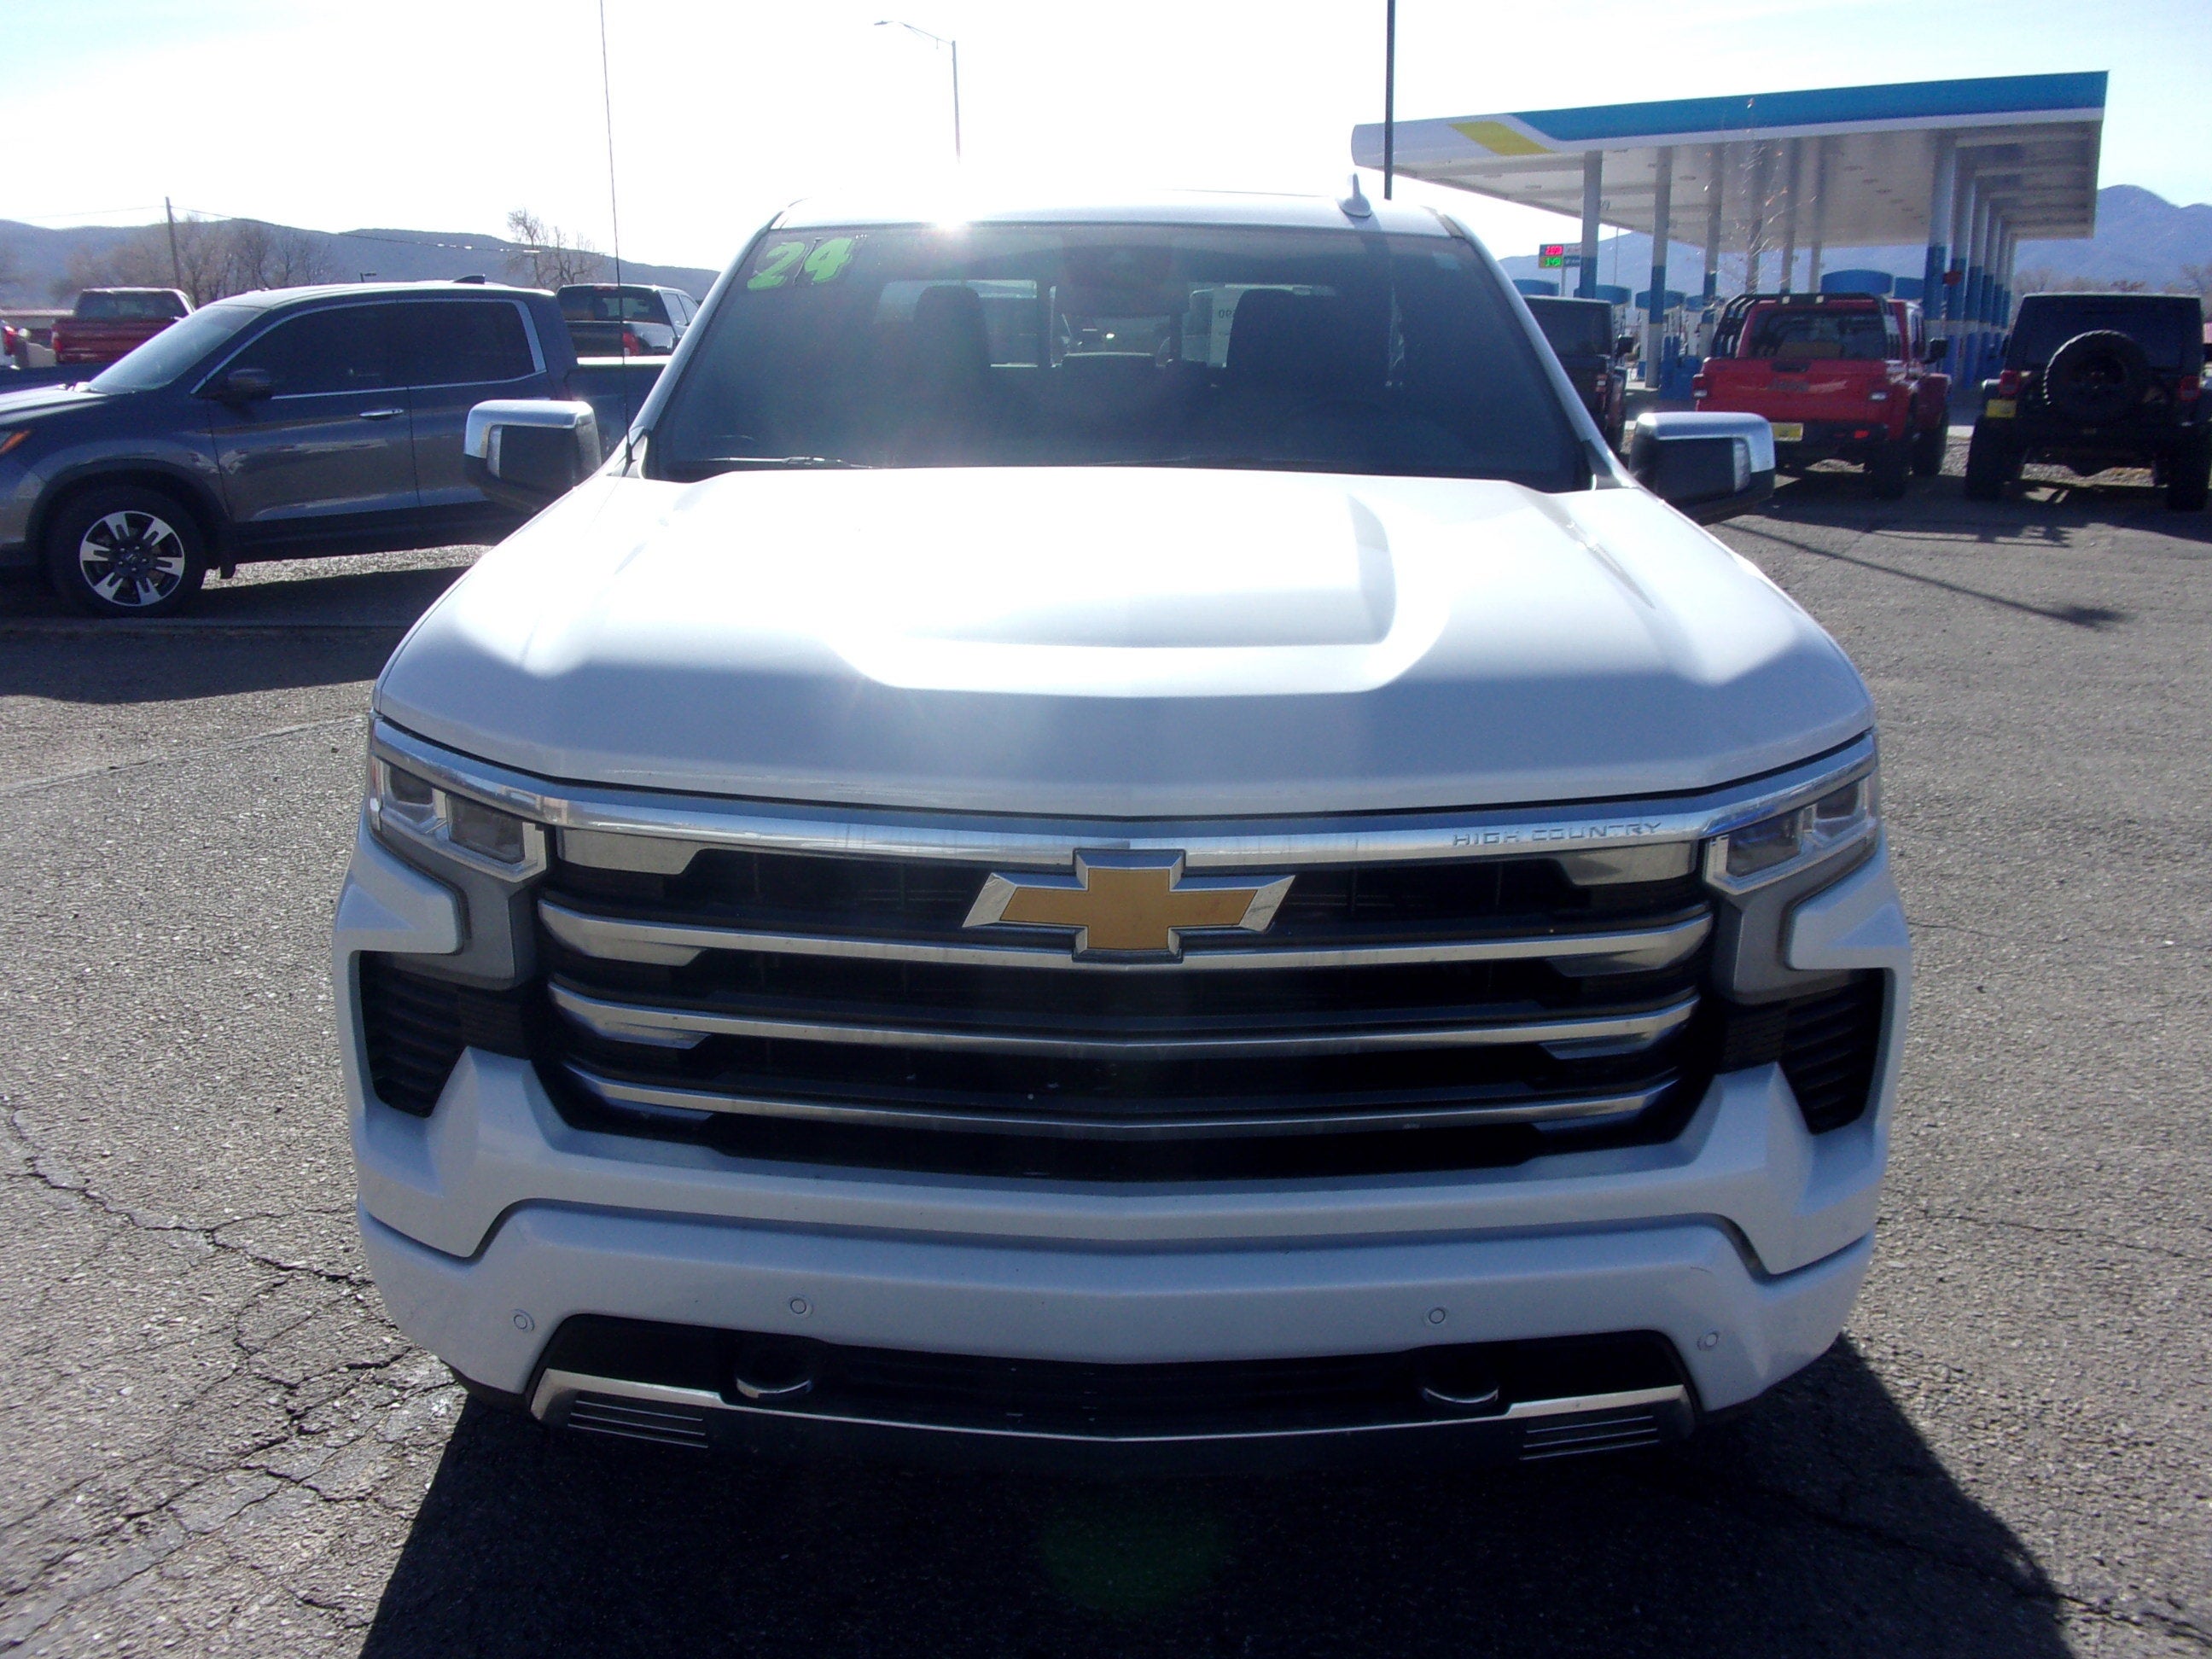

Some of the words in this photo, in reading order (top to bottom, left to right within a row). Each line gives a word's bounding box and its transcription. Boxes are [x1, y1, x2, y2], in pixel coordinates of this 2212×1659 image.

[746, 236, 853, 291] 24
[1452, 830, 1520, 847] HIGH
[1532, 821, 1662, 841] COUNTRY
